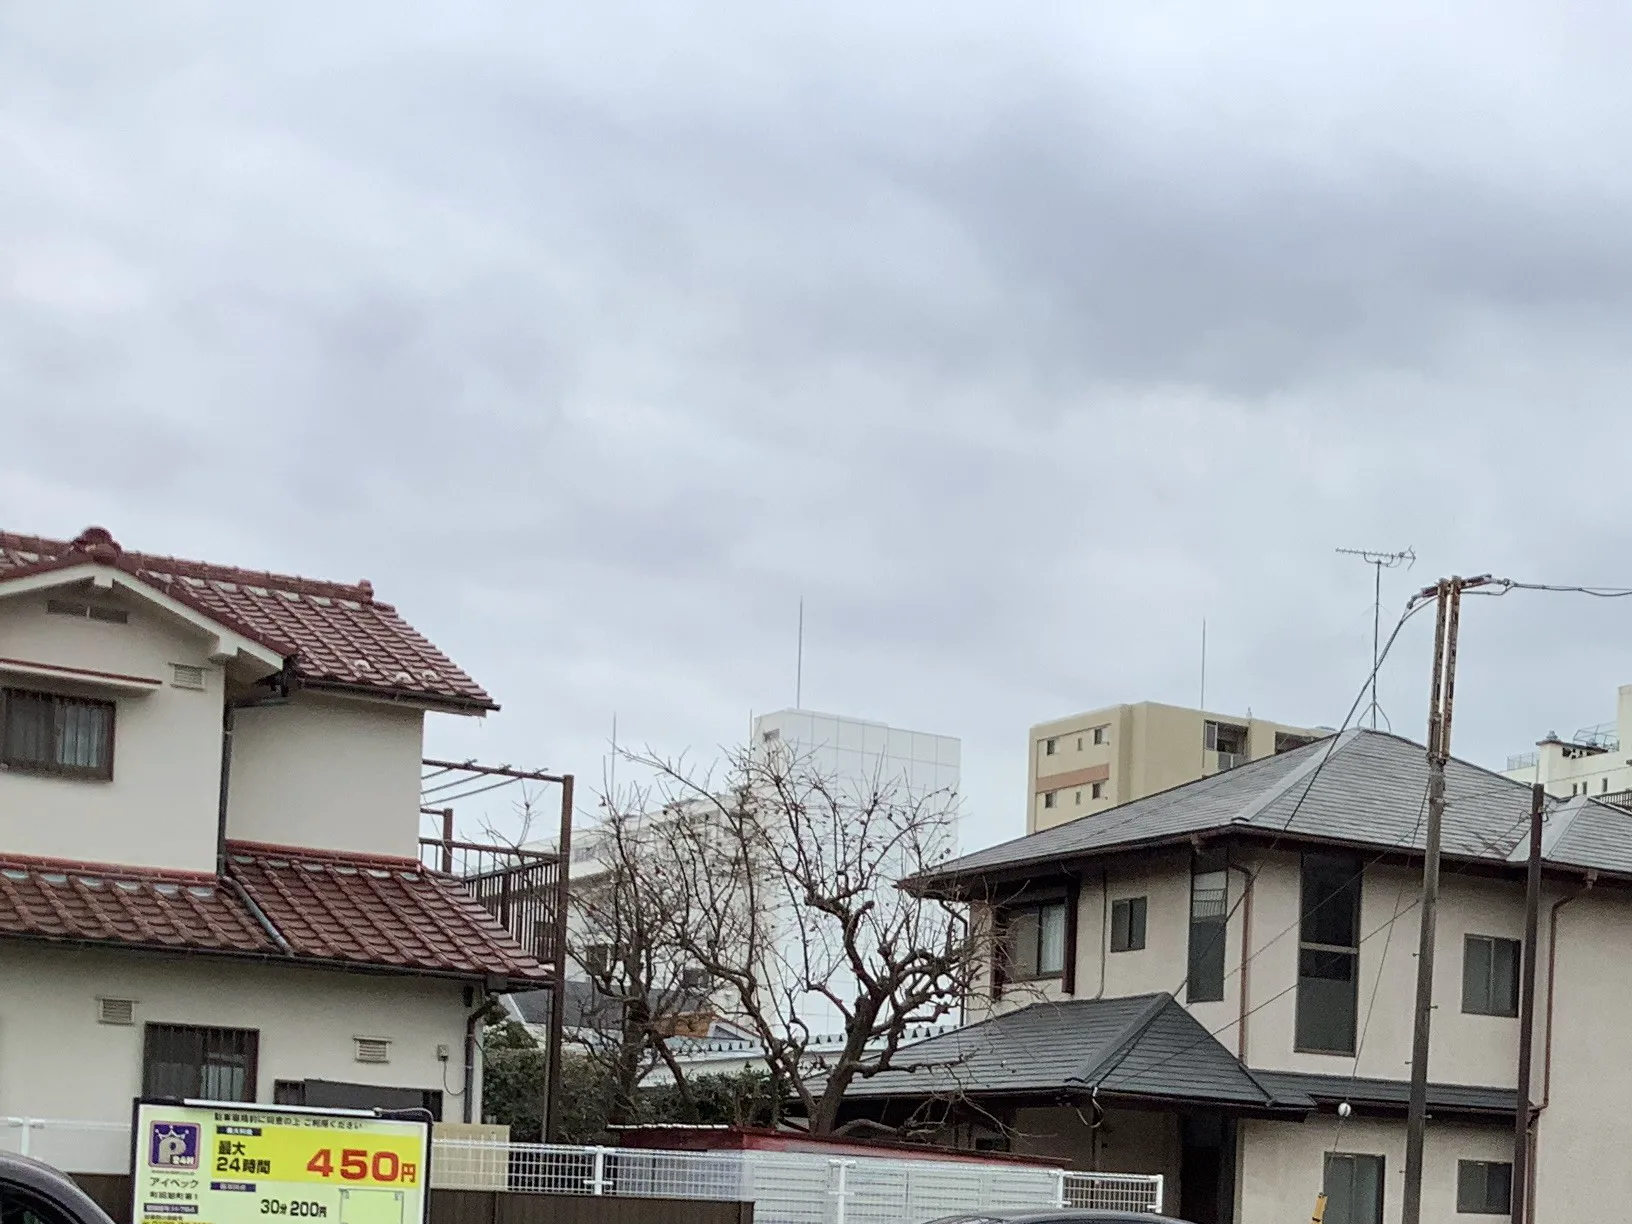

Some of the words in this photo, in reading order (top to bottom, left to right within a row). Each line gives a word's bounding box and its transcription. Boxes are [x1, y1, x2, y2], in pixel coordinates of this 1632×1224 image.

[218, 1140, 247, 1156] 最大
[216, 1157, 271, 1174] 24時間
[307, 1149, 417, 1184] 450円
